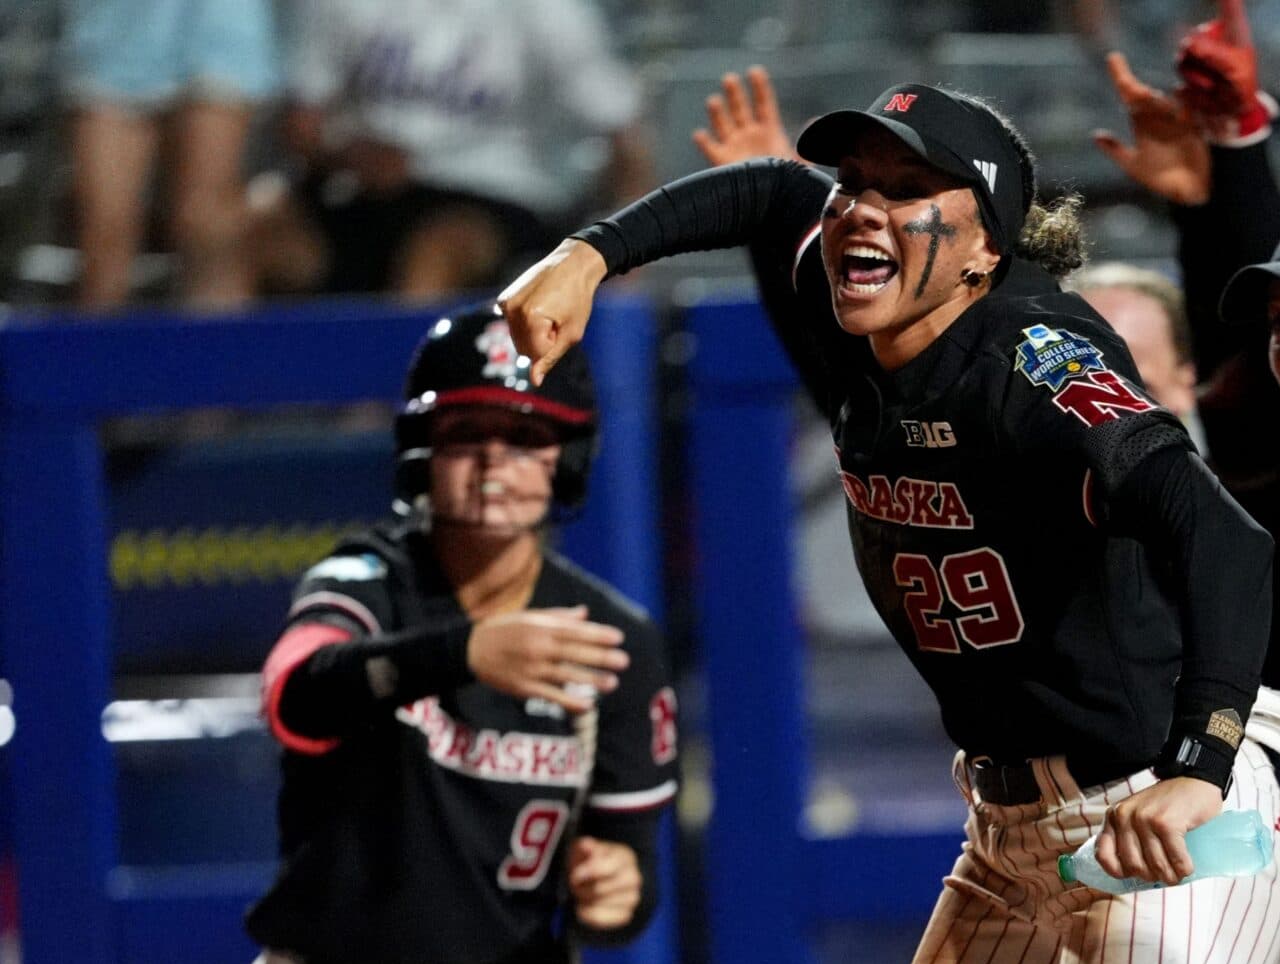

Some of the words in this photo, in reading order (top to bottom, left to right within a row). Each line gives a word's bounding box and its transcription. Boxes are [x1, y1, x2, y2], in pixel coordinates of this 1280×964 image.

[884, 93, 918, 112] N
[1029, 353, 1065, 381] WORLD
[1064, 346, 1097, 361] SERIES
[1037, 341, 1077, 364] COLLEGE
[1052, 369, 1159, 428] N
[893, 546, 1025, 654] 29
[497, 799, 571, 890] 9
